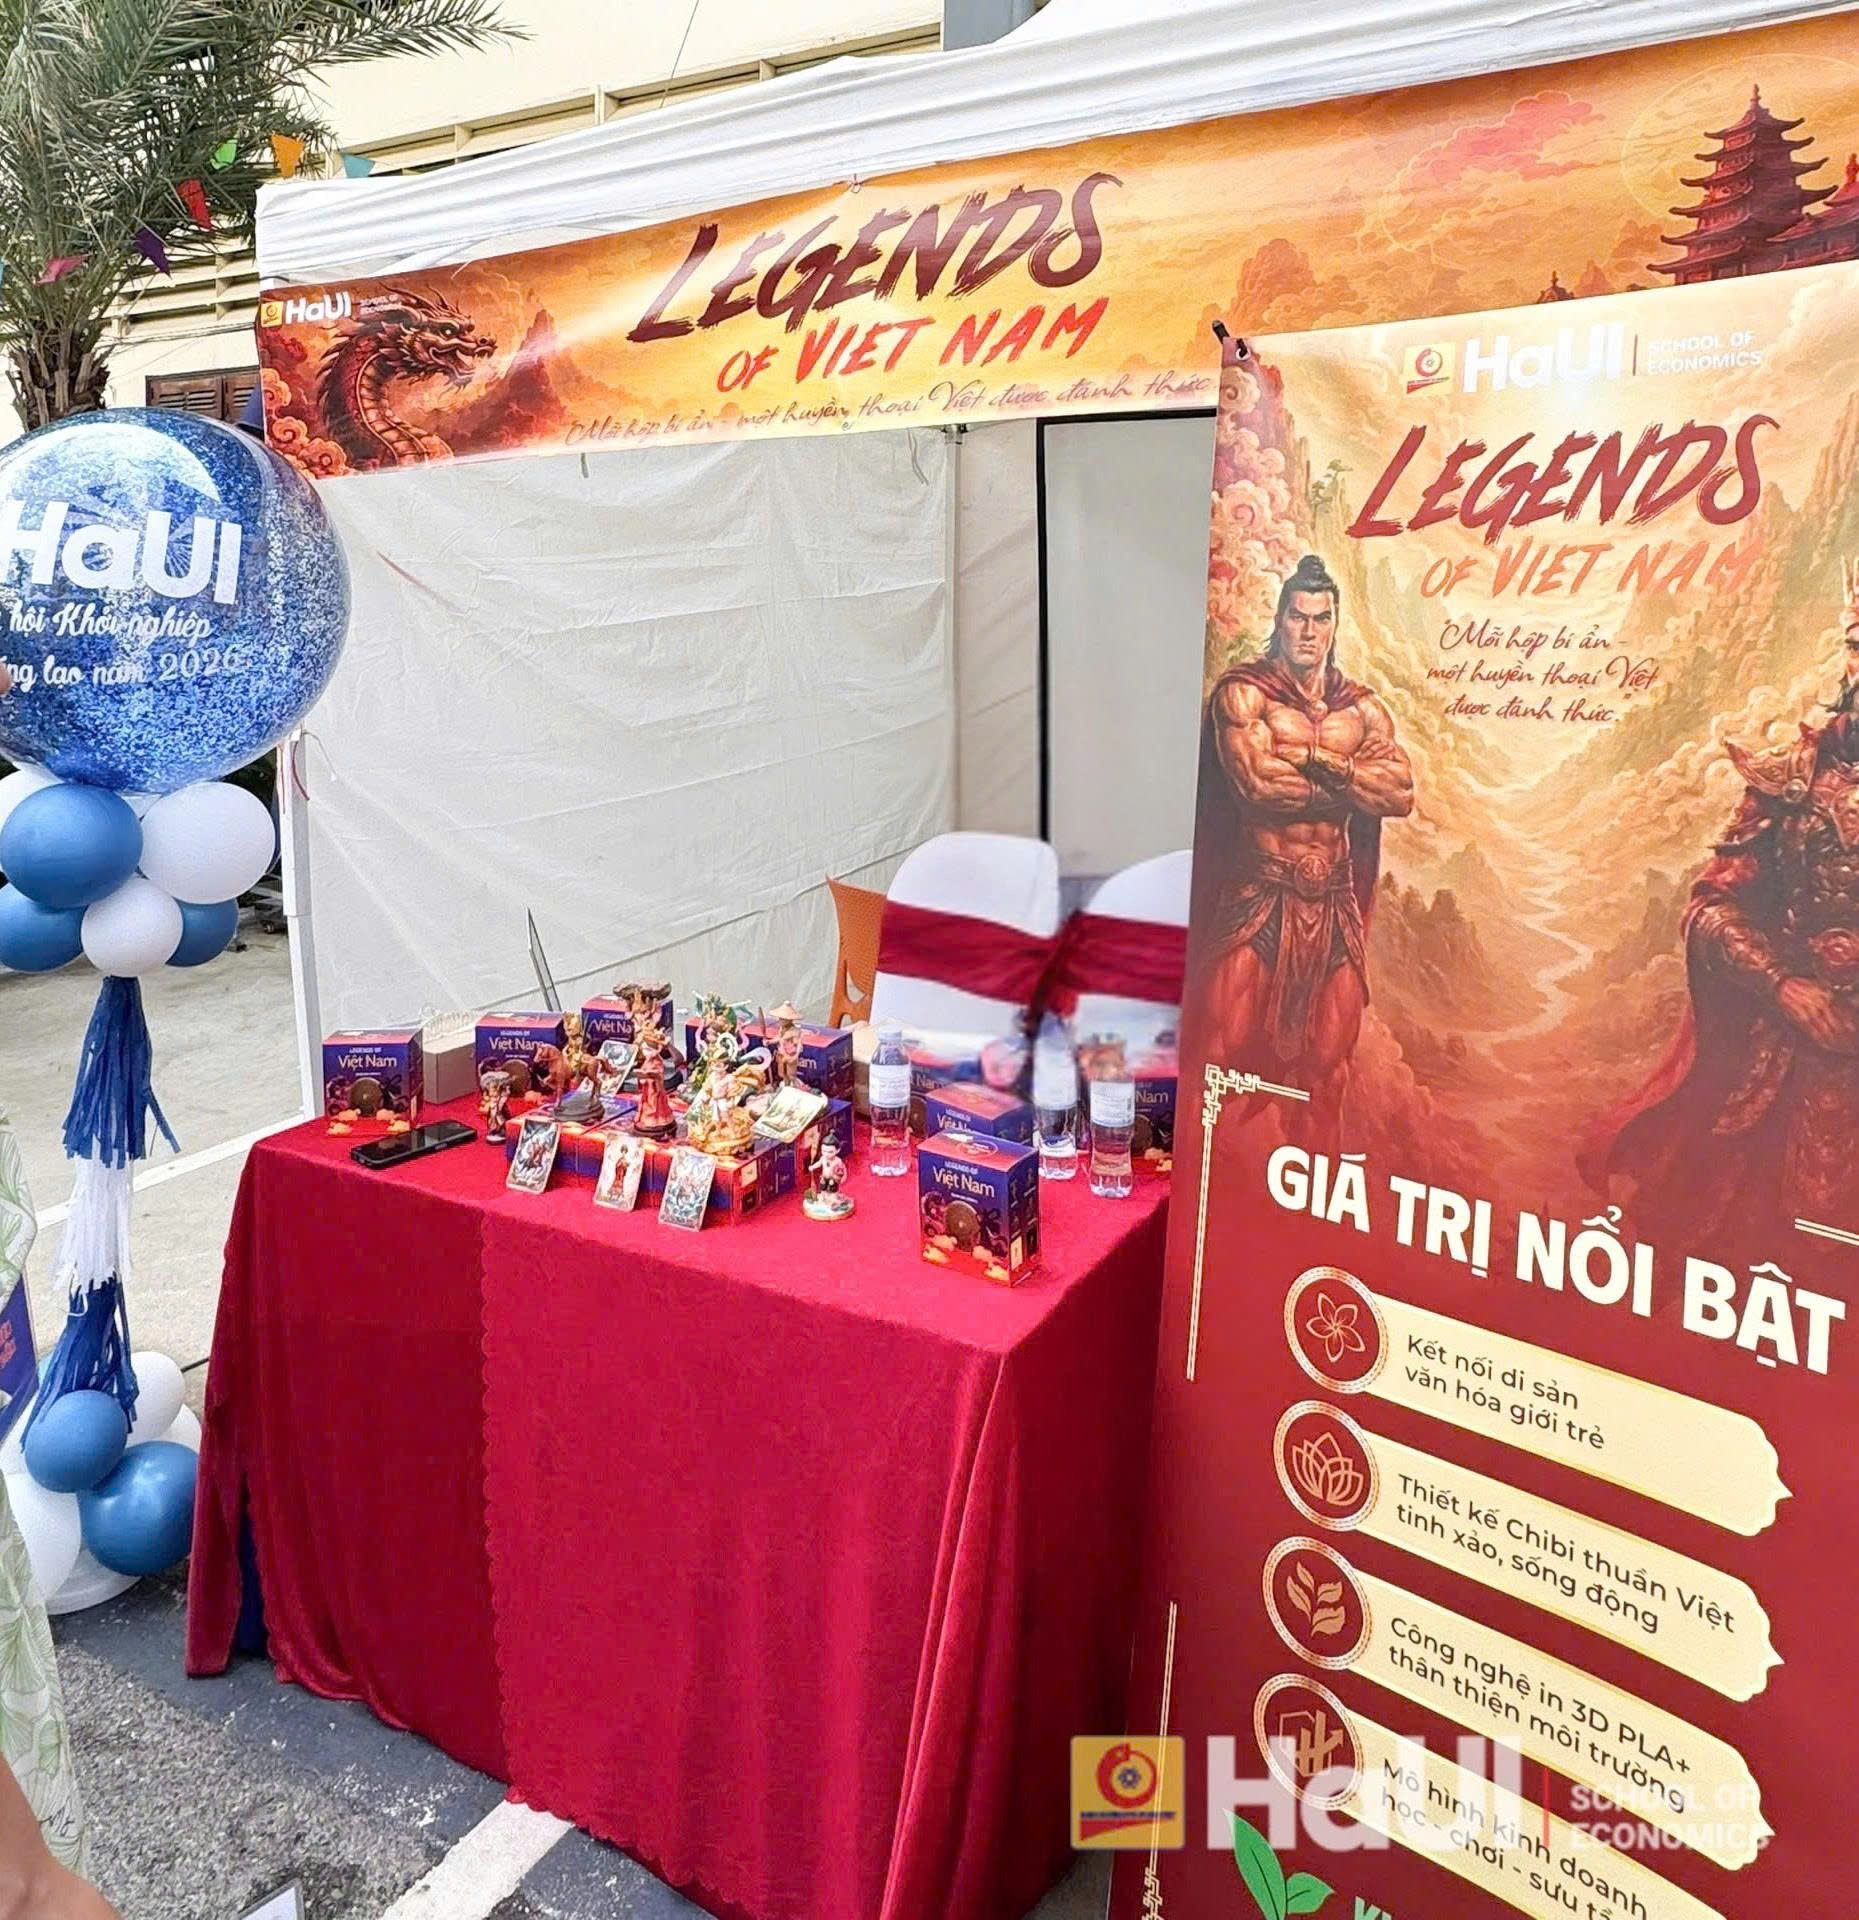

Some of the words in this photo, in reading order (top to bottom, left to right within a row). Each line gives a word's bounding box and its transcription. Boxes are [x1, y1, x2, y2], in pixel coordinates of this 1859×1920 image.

[626, 171, 1124, 342] LEGENDS
[286, 291, 352, 325] HaUI
[1649, 334, 1724, 354] SCHOOL
[1729, 331, 1756, 348] OF
[716, 345, 780, 393] OF
[796, 317, 936, 383] VIET
[938, 296, 1111, 367] NAM
[1463, 324, 1627, 393] HaUI
[1648, 350, 1762, 377] ECONOMICS
[928, 379, 987, 411] Việt
[1345, 413, 1782, 546] LEGENDS
[0, 499, 243, 605] HaUI
[1420, 555, 1479, 598] OF
[1492, 535, 1615, 598] VIET
[1616, 536, 1766, 594] NAM
[159, 644, 238, 682] 2026
[1439, 618, 1502, 650] Mỗi
[1506, 624, 1549, 660] hộp
[1553, 625, 1573, 649] bí
[1578, 624, 1610, 649] ẩn
[1426, 660, 1469, 685] một
[1470, 659, 1534, 689] huyền
[1541, 662, 1603, 690] thoại
[1605, 655, 1661, 693] Việt
[1444, 694, 1492, 721] được
[1495, 696, 1555, 719] đánh
[1561, 697, 1621, 723] thức.
[338, 1054, 364, 1070] Việt
[365, 1054, 397, 1068] Nam
[617, 1021, 632, 1034] Na
[1135, 1089, 1169, 1104] Nam
[932, 1165, 961, 1190] Việt
[961, 1172, 995, 1198] Nam
[1267, 1145, 1370, 1233] GIÁ
[1389, 1175, 1492, 1278] TRỊ
[1515, 1204, 1654, 1319] NỔI
[1683, 1255, 1846, 1376] BẬT
[1408, 1334, 1447, 1365] Kết
[1455, 1354, 1493, 1380] nối
[1501, 1368, 1525, 1391] di
[1533, 1379, 1579, 1410] sản
[1405, 1366, 1447, 1393] văn
[1456, 1379, 1501, 1413] hóa
[1510, 1402, 1558, 1433] giới
[1566, 1420, 1605, 1450] trẻ
[1397, 1504, 1445, 1539] tinh
[1453, 1529, 1503, 1567] xảo,
[1511, 1555, 1577, 1597] sống
[1586, 1583, 1659, 1635] động
[1398, 1473, 1461, 1516] Thiết
[1468, 1501, 1500, 1530] kế
[1506, 1518, 1575, 1561] Chibi
[1583, 1549, 1667, 1602] thuần
[1677, 1586, 1736, 1633] Việt
[1389, 1645, 1444, 1687] thân
[1452, 1675, 1520, 1723] thiện
[1530, 1714, 1580, 1753] môi
[1588, 1741, 1687, 1814] trường
[1391, 1617, 1455, 1665] Công
[1464, 1652, 1531, 1701] nghệ
[1539, 1682, 1563, 1712] in
[1572, 1699, 1609, 1732] 3D
[1618, 1722, 1691, 1775] PLA+
[1382, 1787, 1426, 1827] học
[1450, 1828, 1505, 1869] chơi
[1530, 1871, 1578, 1912] sưu
[1384, 1757, 1420, 1791] Mô
[1428, 1780, 1484, 1826] hình
[1493, 1814, 1550, 1864] kinh
[1560, 1857, 1647, 1920] doanh
